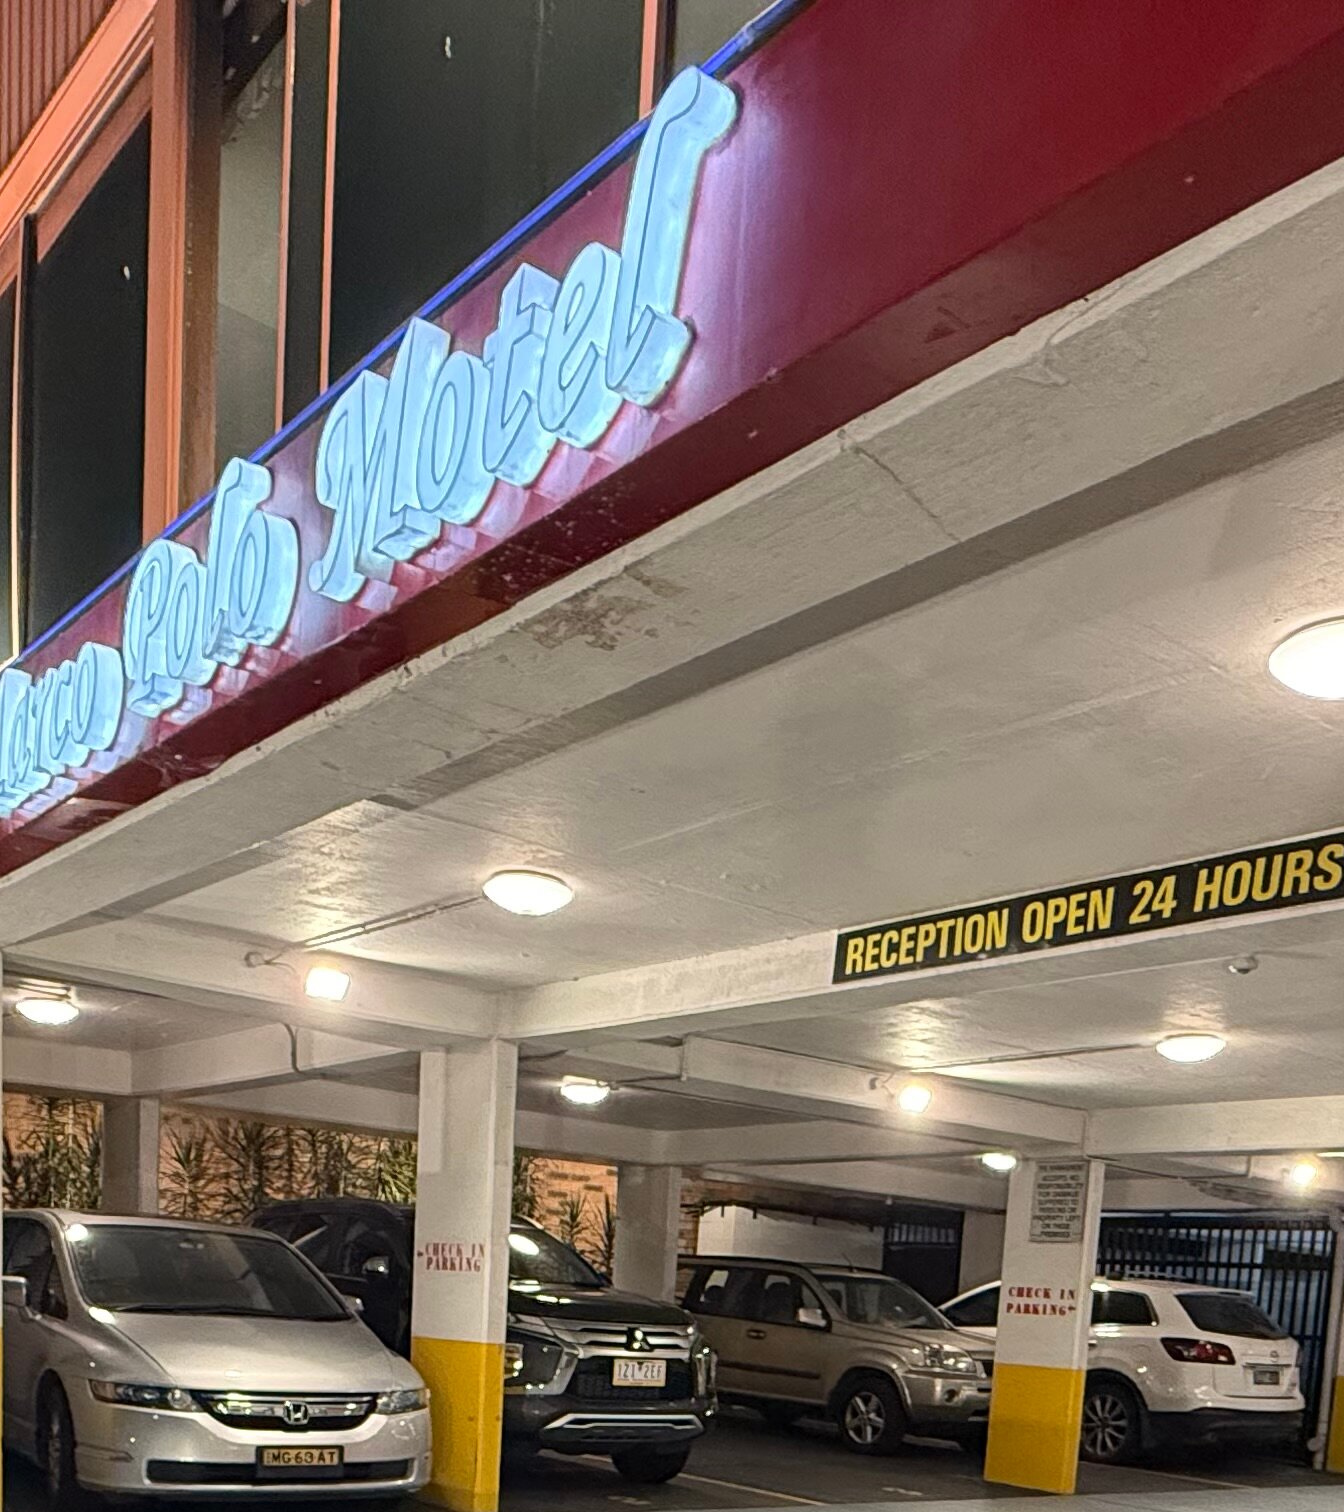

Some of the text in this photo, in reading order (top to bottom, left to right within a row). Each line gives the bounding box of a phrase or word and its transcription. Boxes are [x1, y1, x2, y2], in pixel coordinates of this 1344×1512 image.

[123, 456, 301, 718] Polo
[308, 65, 737, 602] Motel
[844, 907, 1010, 976] RECEPTION
[1022, 885, 1116, 944] OPEN
[1128, 874, 1178, 926] 24
[425, 1242, 485, 1258] CHECK IN
[426, 1256, 481, 1272] PARKING
[1008, 1286, 1075, 1300] CHECK IN
[1006, 1302, 1066, 1316] PARKING
